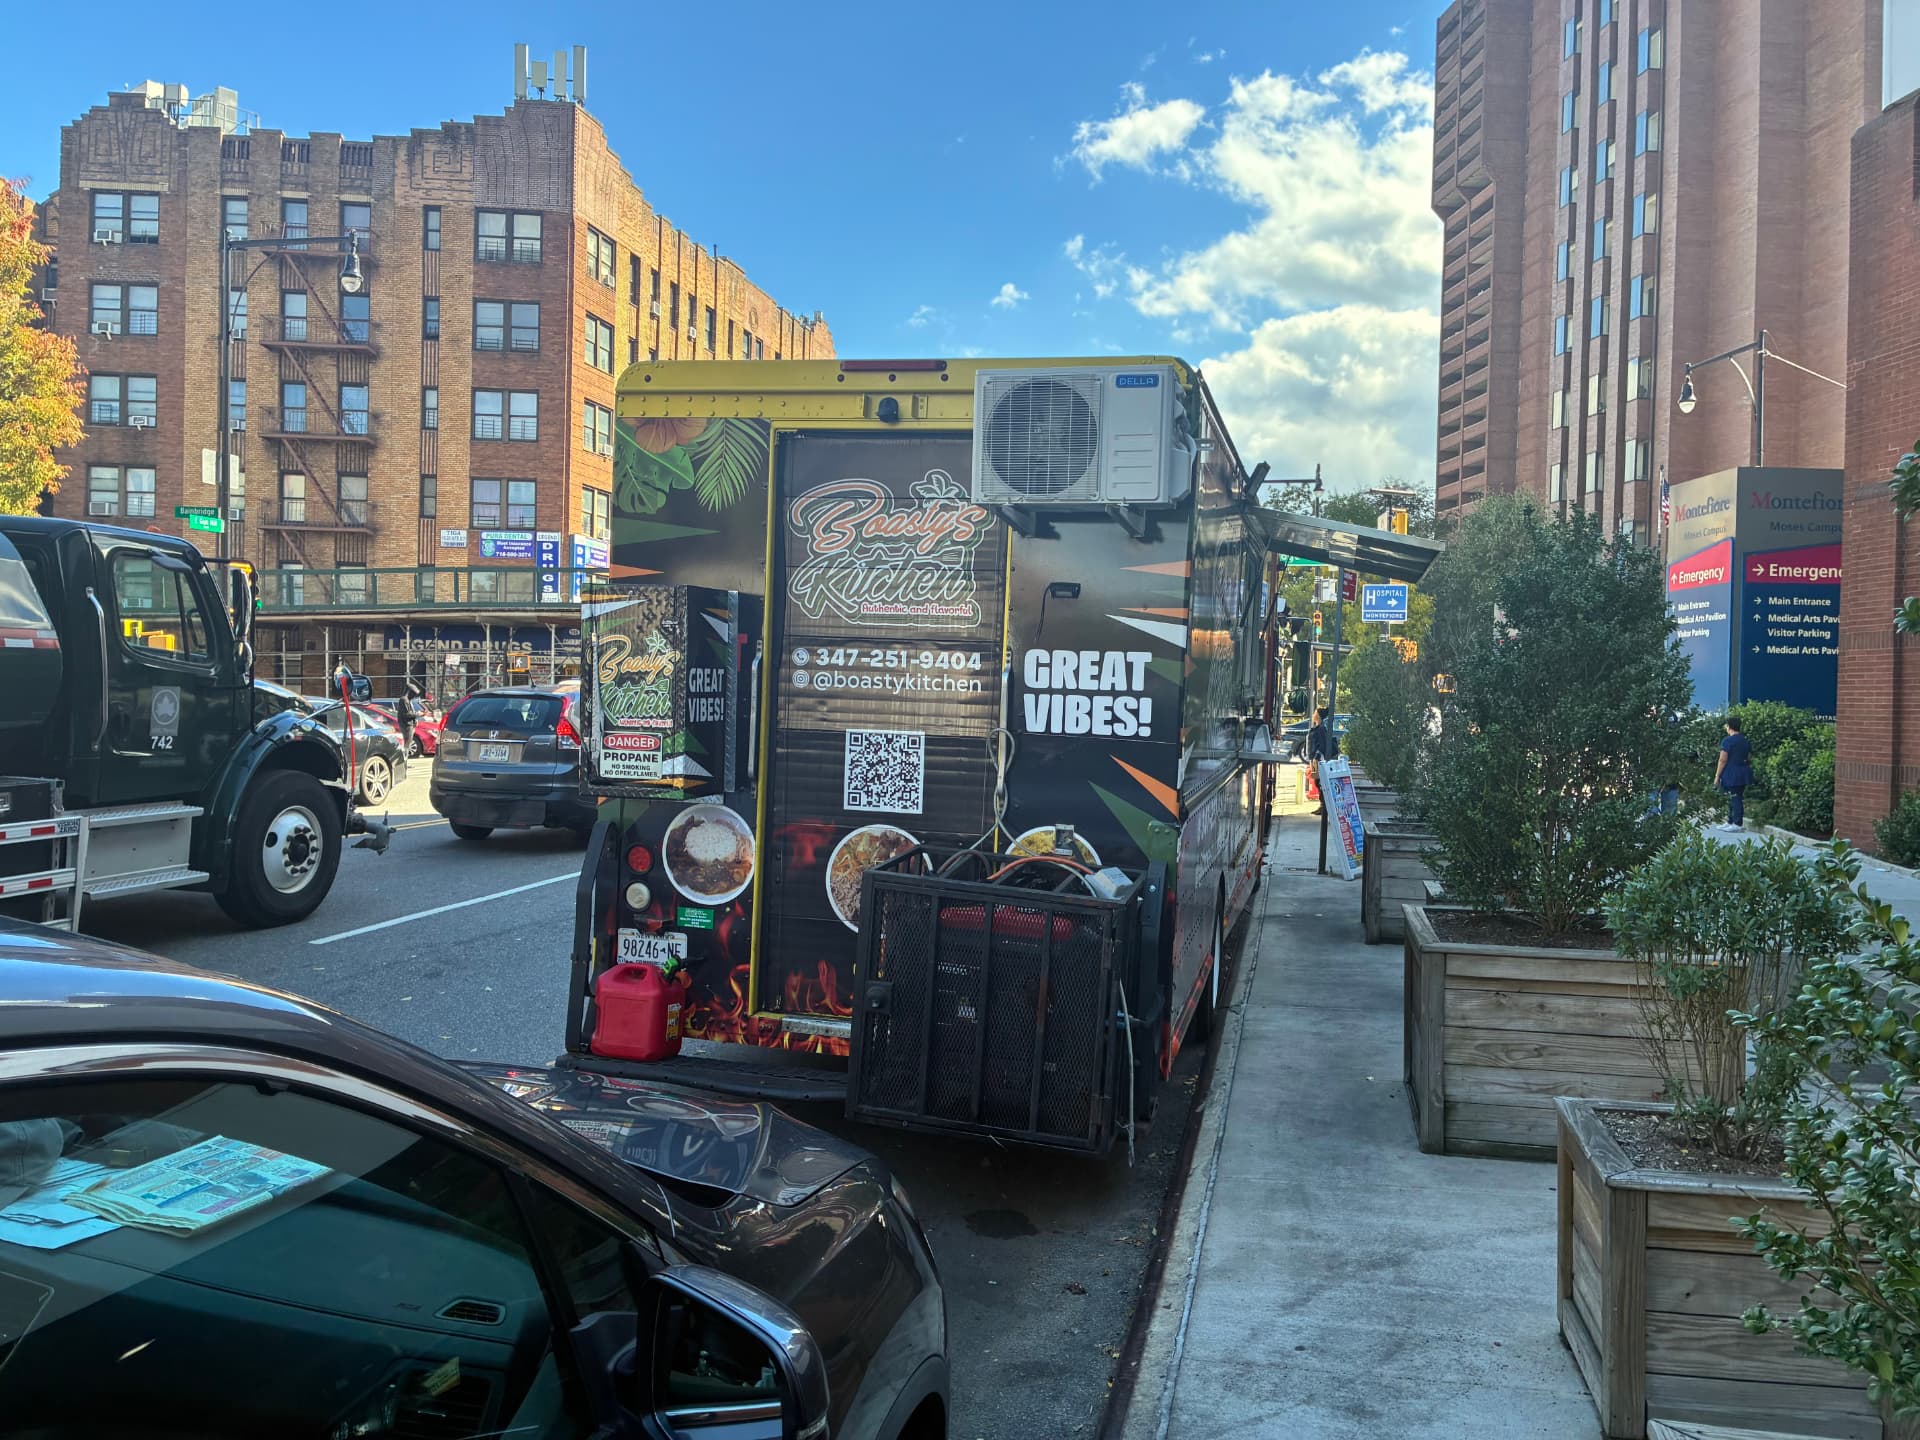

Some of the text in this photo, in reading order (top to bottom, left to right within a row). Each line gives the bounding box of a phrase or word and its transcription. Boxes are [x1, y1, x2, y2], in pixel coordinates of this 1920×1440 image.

[1119, 377, 1154, 385] DELLA
[1751, 490, 1842, 511] Montefior
[180, 507, 215, 516] Bainbridge
[1675, 496, 1730, 523] Montefiore
[1684, 526, 1727, 540] Moses Campus
[1770, 521, 1803, 532] Moses
[792, 549, 967, 613] Kitchen
[1679, 566, 1724, 585] Emergency
[1366, 590, 1404, 606] HOSPITAL
[1768, 597, 1832, 606] Main Entrance
[861, 603, 973, 616] Authentic and flavorful
[1678, 601, 1710, 611] Main Entrance
[1695, 615, 1704, 623] Arts
[1705, 612, 1727, 622] Pavilion
[1768, 614, 1840, 623] Medical Arts Pavi
[1678, 628, 1710, 638] Visitor Parking
[1767, 628, 1831, 639] Visitor Parking
[388, 638, 533, 652] LEGEND DRUGS
[1767, 646, 1839, 655] Medical Arts Pavi
[816, 648, 982, 671] 347-251-9404
[1024, 649, 1152, 691] GREAT
[688, 668, 725, 693] GREAT
[813, 671, 982, 694] @boastykitchen
[688, 697, 725, 723] VIBES!
[1023, 693, 1153, 738] VIBES!
[151, 735, 173, 750] 742
[608, 736, 655, 749] DANGER
[604, 752, 659, 764] PROPANE
[622, 764, 651, 772] SMOKING
